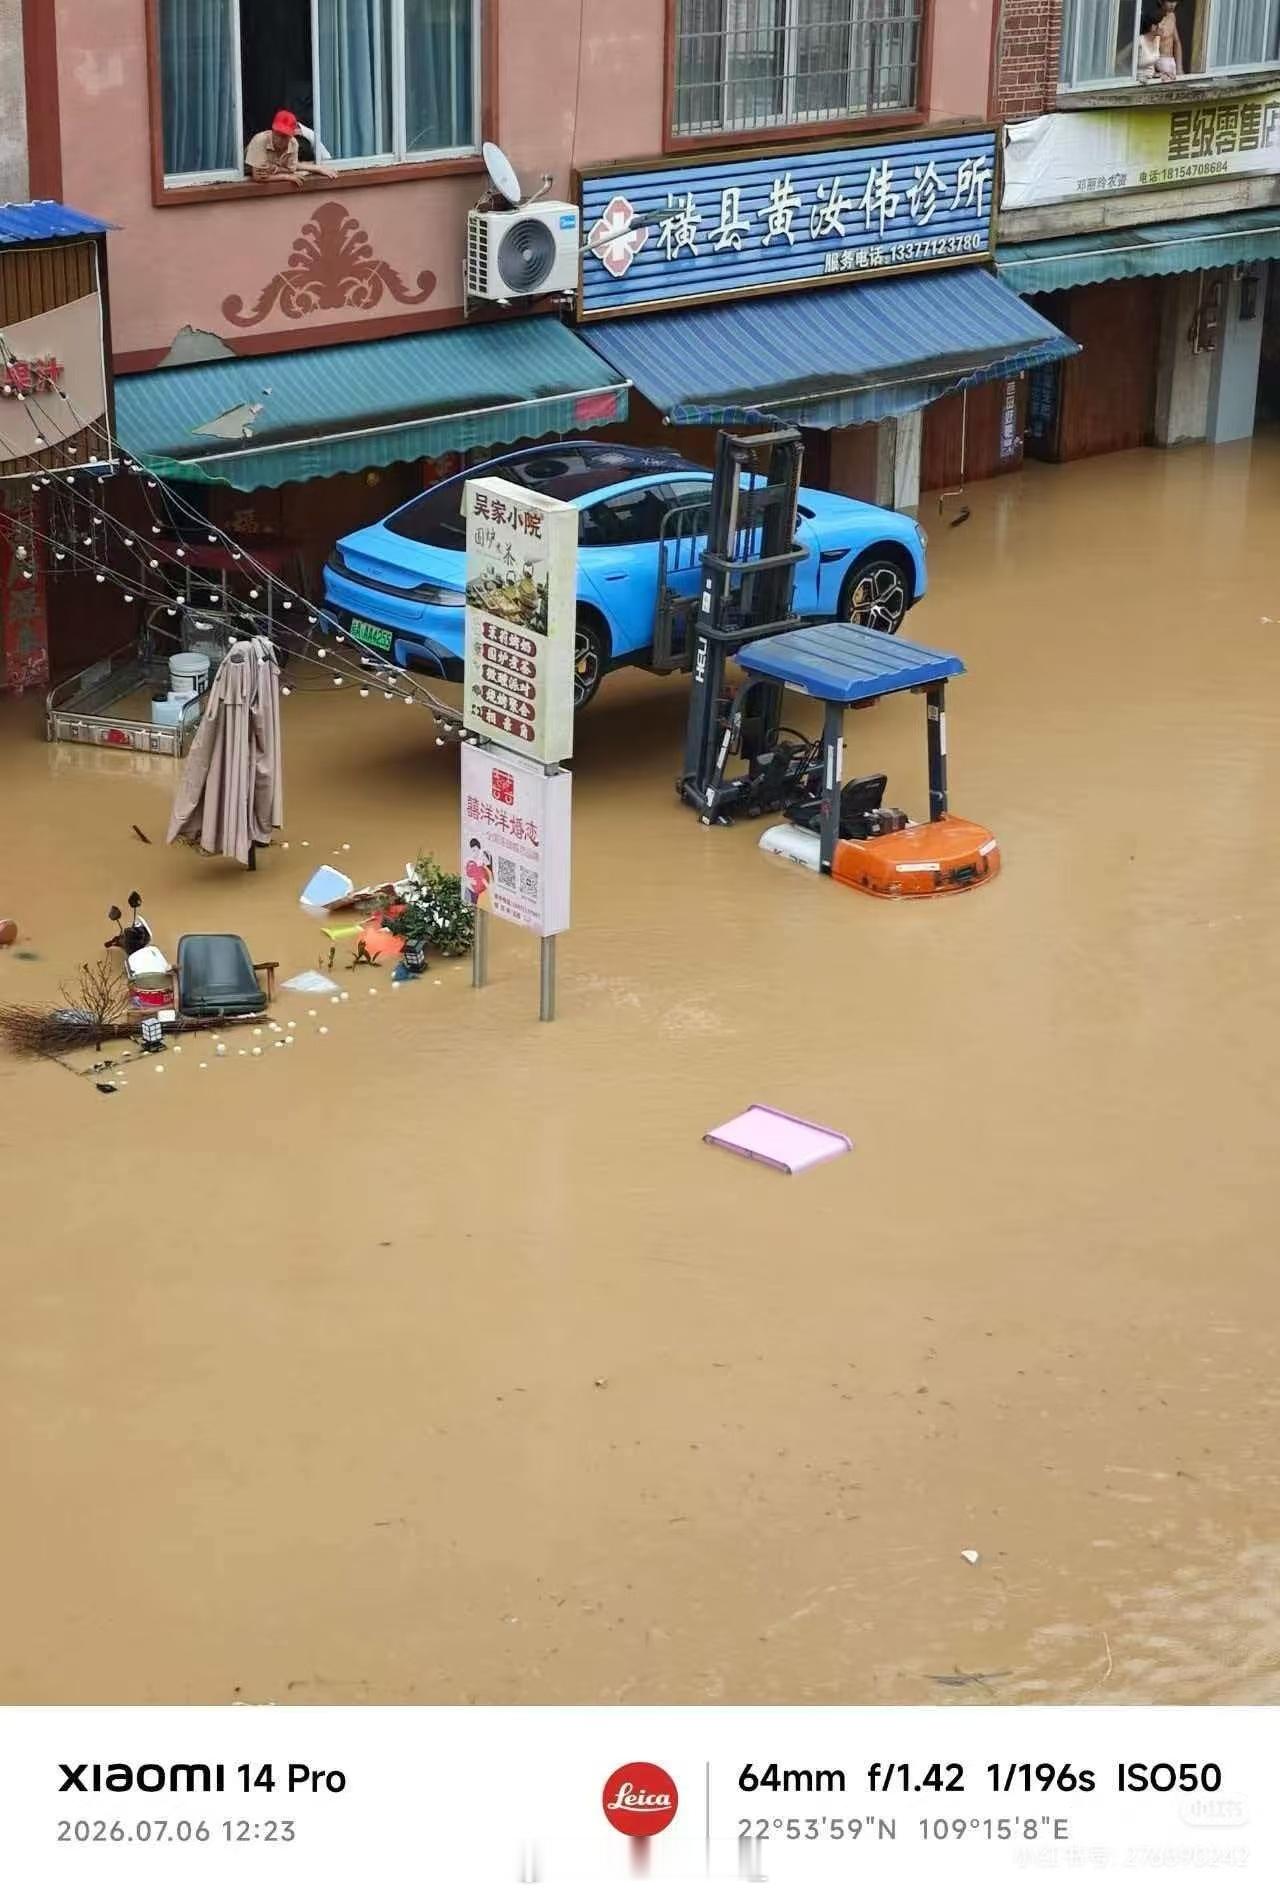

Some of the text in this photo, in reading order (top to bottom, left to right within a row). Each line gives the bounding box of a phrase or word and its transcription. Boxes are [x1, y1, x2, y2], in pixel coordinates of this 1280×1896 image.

[655, 154, 993, 261] 横县黄汝伟诊所
[473, 492, 542, 539] 吴家小院
